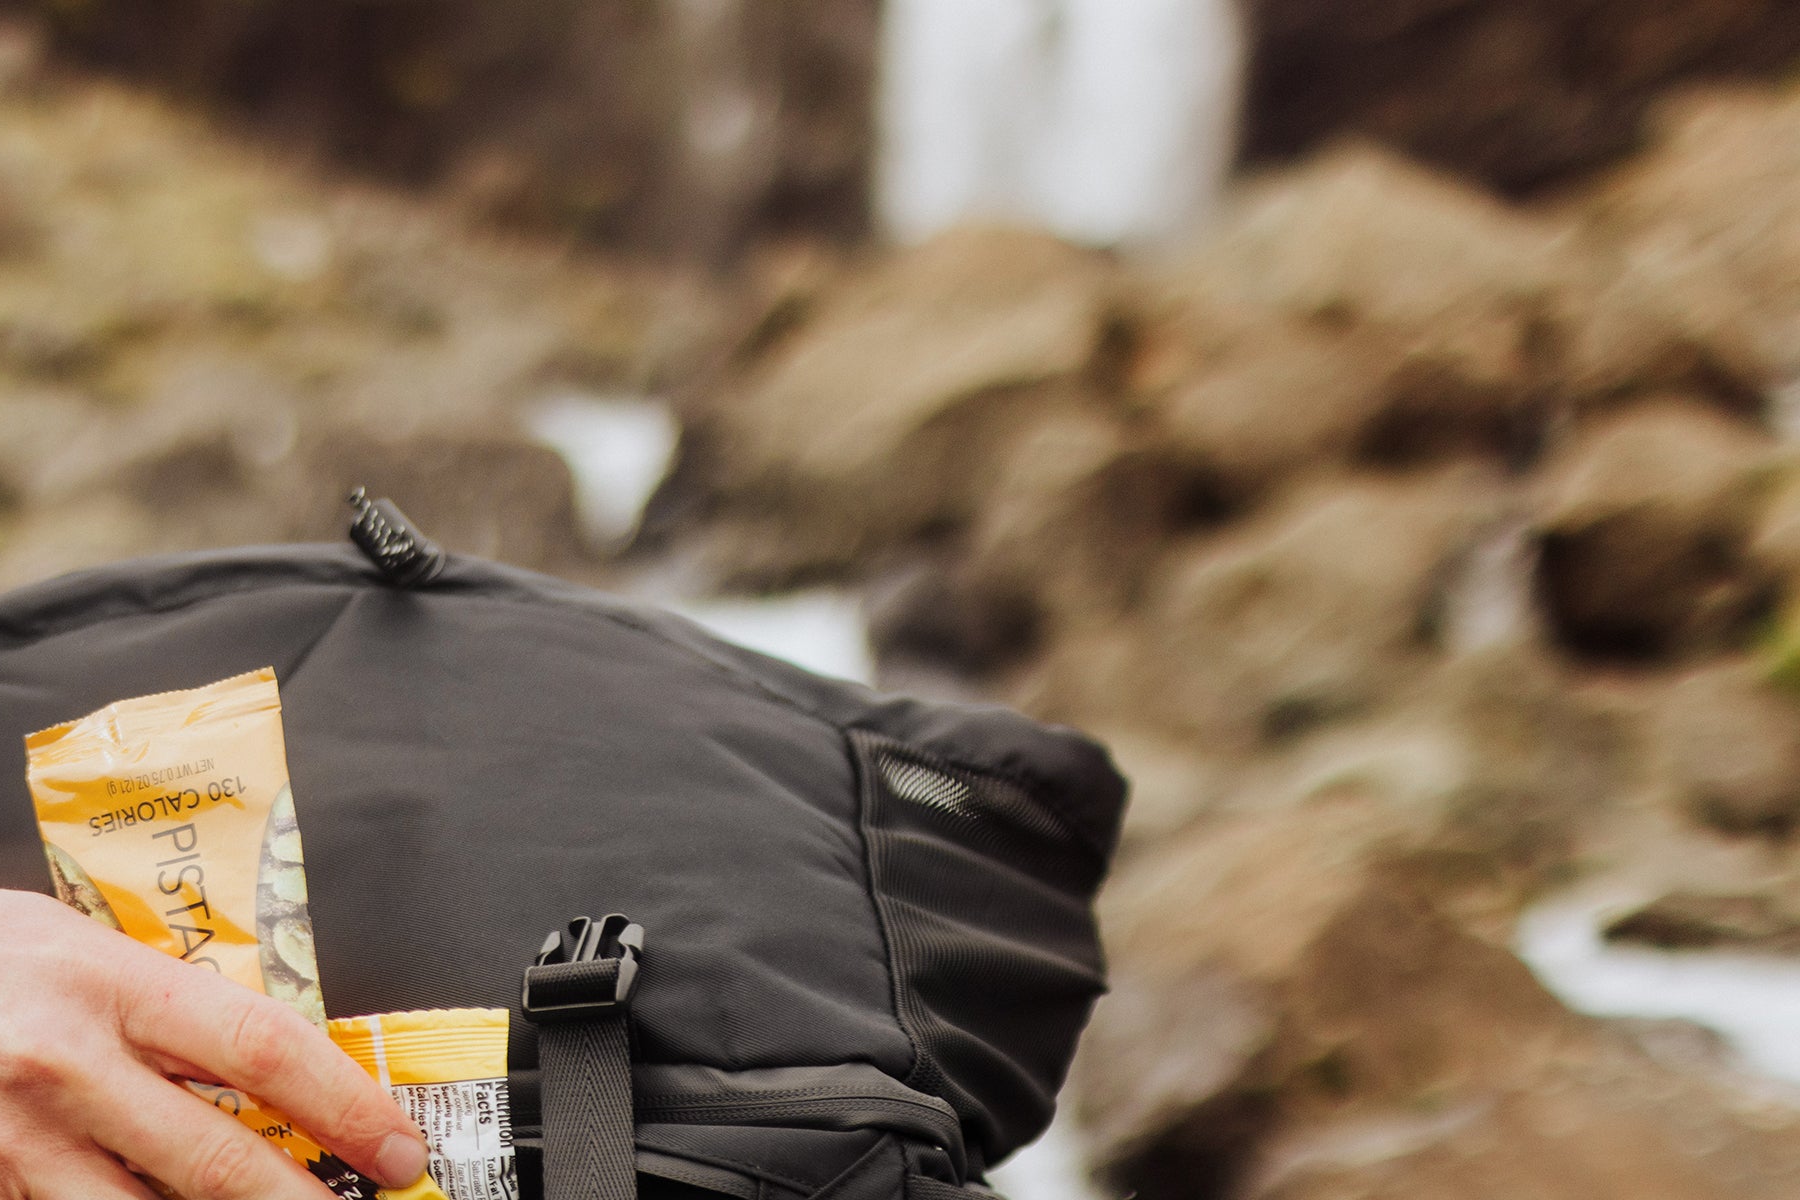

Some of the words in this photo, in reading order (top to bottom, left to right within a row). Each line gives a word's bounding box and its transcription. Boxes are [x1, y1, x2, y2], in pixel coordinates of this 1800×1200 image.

[151, 767, 175, 786] 0.75
[177, 763, 194, 778] WT
[194, 758, 215, 774] NET
[106, 781, 118, 798] g)
[121, 776, 136, 795] (21
[137, 774, 151, 790] OZ
[207, 776, 247, 802] 130
[88, 788, 201, 837] CALORIES
[152, 823, 221, 974] PISTA
[450, 1084, 460, 1096] per
[415, 1086, 430, 1127] Calories
[433, 1094, 443, 1131] Package
[441, 1085, 453, 1118] Serving
[462, 1091, 473, 1116] serving
[475, 1082, 494, 1125] Facts
[454, 1098, 464, 1131] container
[445, 1120, 453, 1138] size
[457, 1162, 467, 1182] Trans
[471, 1160, 485, 1196] Saturated
[486, 1157, 497, 1181] Total
[458, 1184, 469, 1197] Fat
[489, 1181, 500, 1196] Fat
